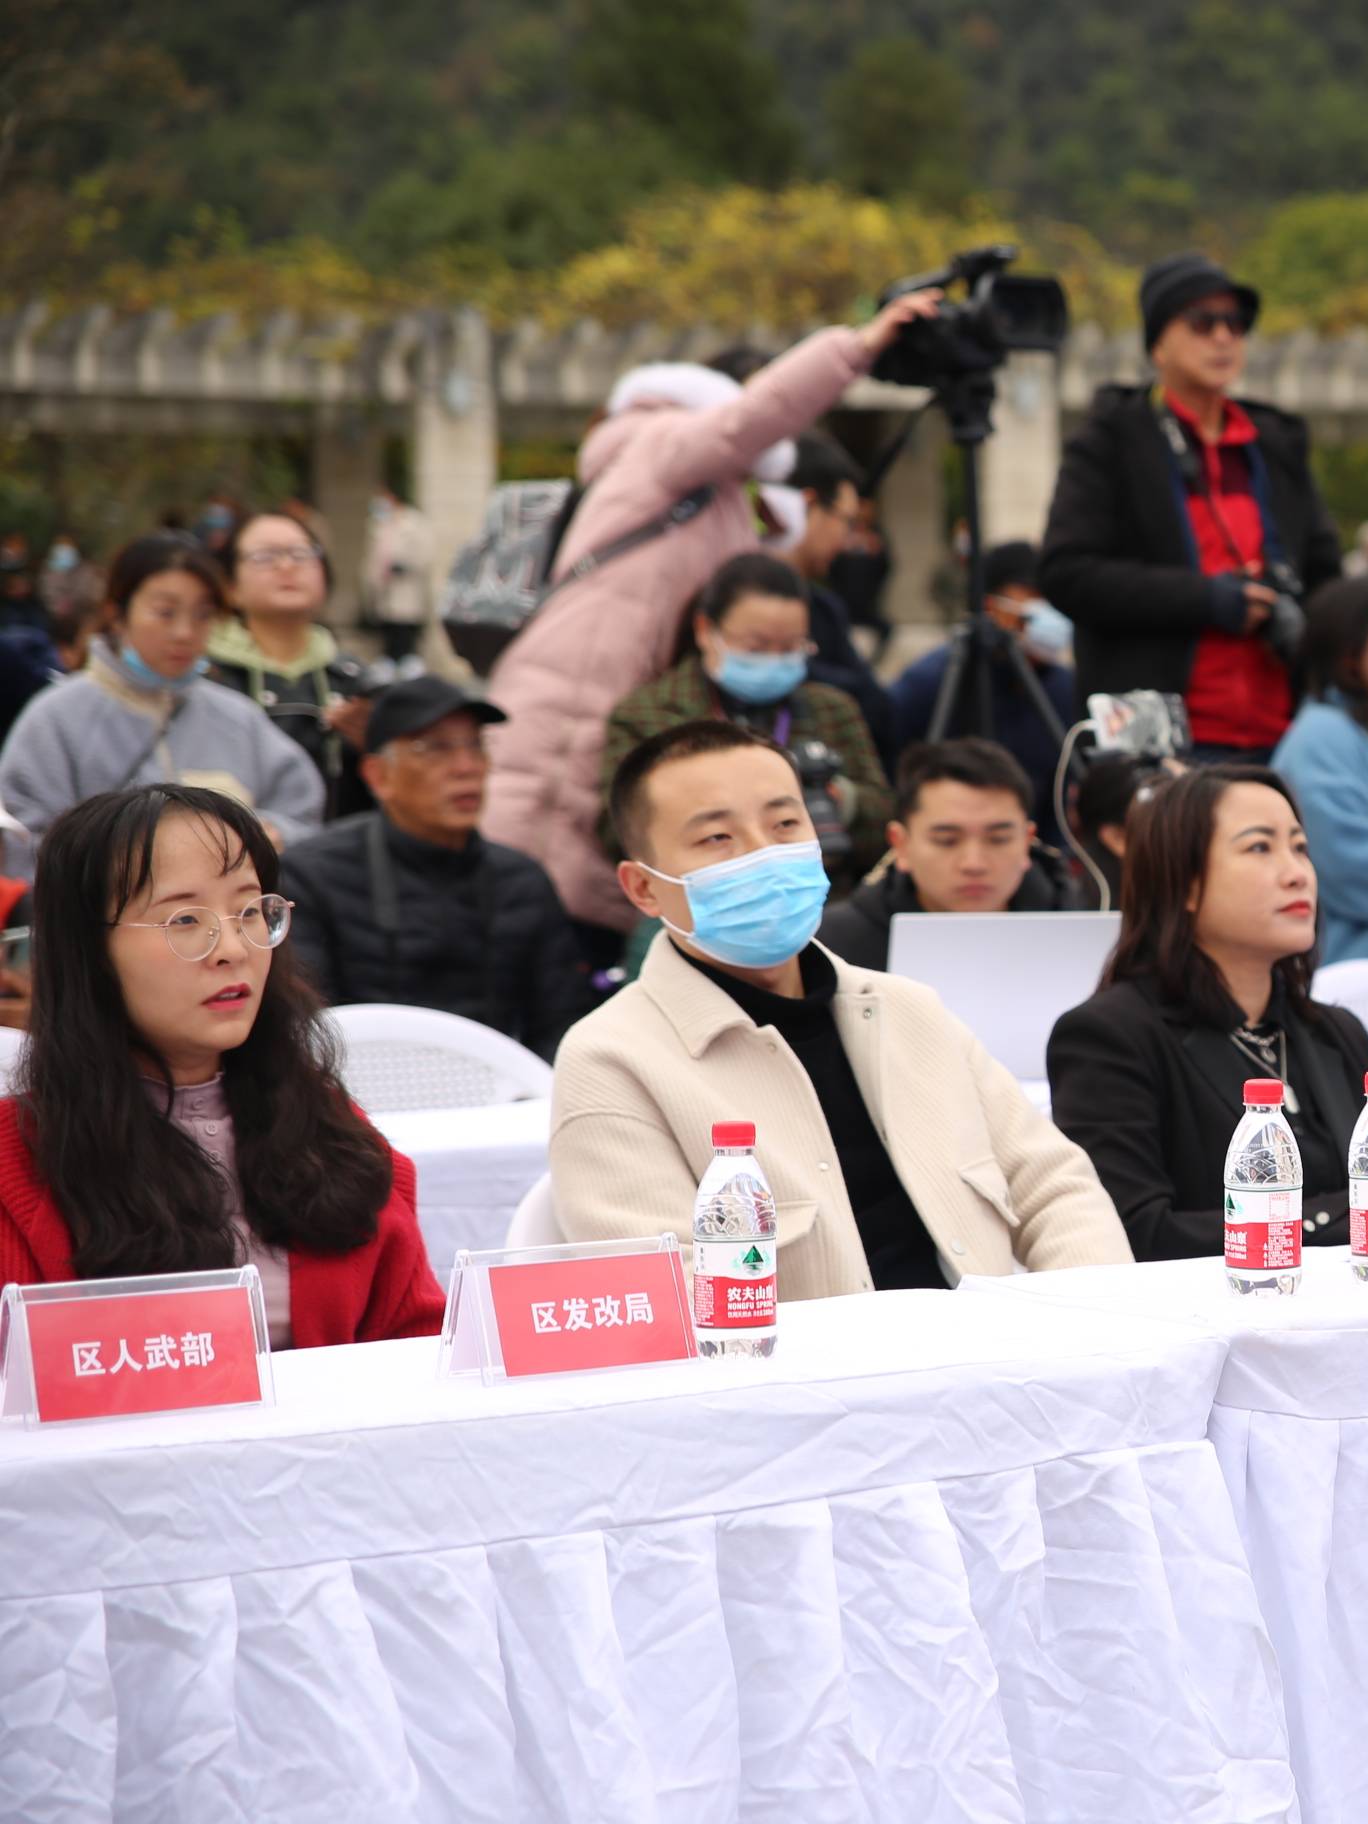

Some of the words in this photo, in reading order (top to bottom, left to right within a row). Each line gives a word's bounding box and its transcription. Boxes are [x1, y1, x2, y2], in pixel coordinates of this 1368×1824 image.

[531, 1292, 654, 1334] 区发改局
[72, 1332, 215, 1377] 区人武部
